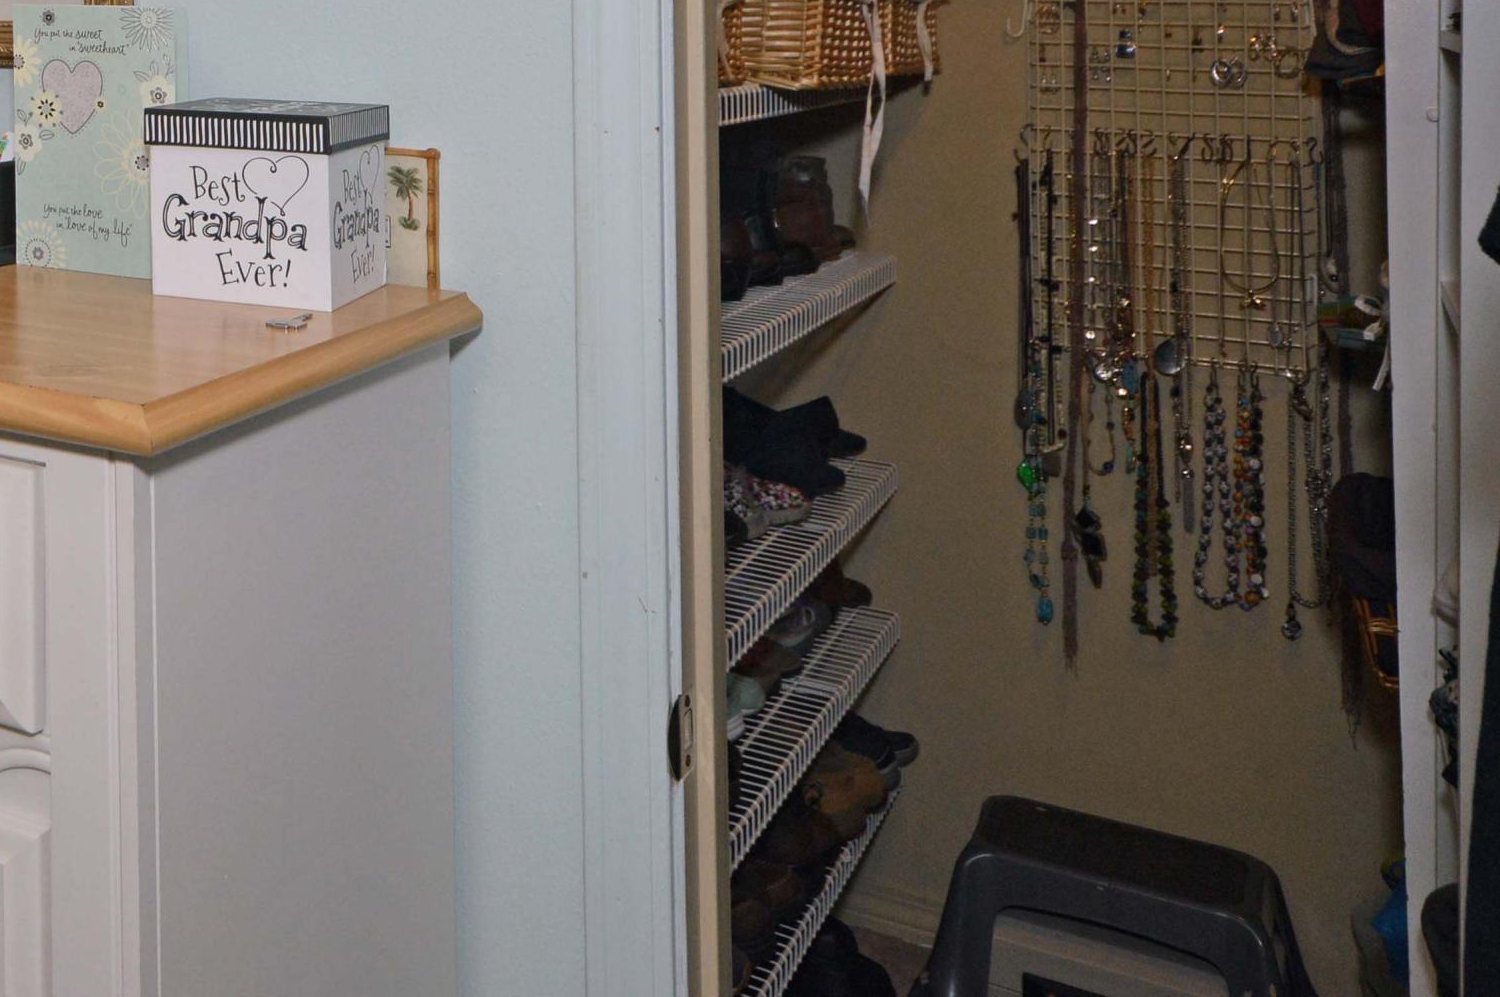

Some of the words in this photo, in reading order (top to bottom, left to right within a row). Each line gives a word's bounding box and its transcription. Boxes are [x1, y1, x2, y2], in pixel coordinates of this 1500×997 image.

[34, 28, 49, 45] You
[50, 29, 61, 41] put
[62, 29, 73, 38] the
[75, 29, 103, 41] sweet
[189, 165, 246, 206] Best
[342, 169, 362, 205] Best
[43, 203, 57, 219] You
[58, 205, 70, 217] put
[70, 205, 82, 216] the
[82, 203, 103, 219] love
[162, 193, 309, 260] Grandpa
[333, 189, 380, 251] Grandpa
[88, 222, 99, 240] of
[99, 226, 110, 241] my
[215, 248, 292, 288] Ever!
[350, 243, 375, 284] Ever!
